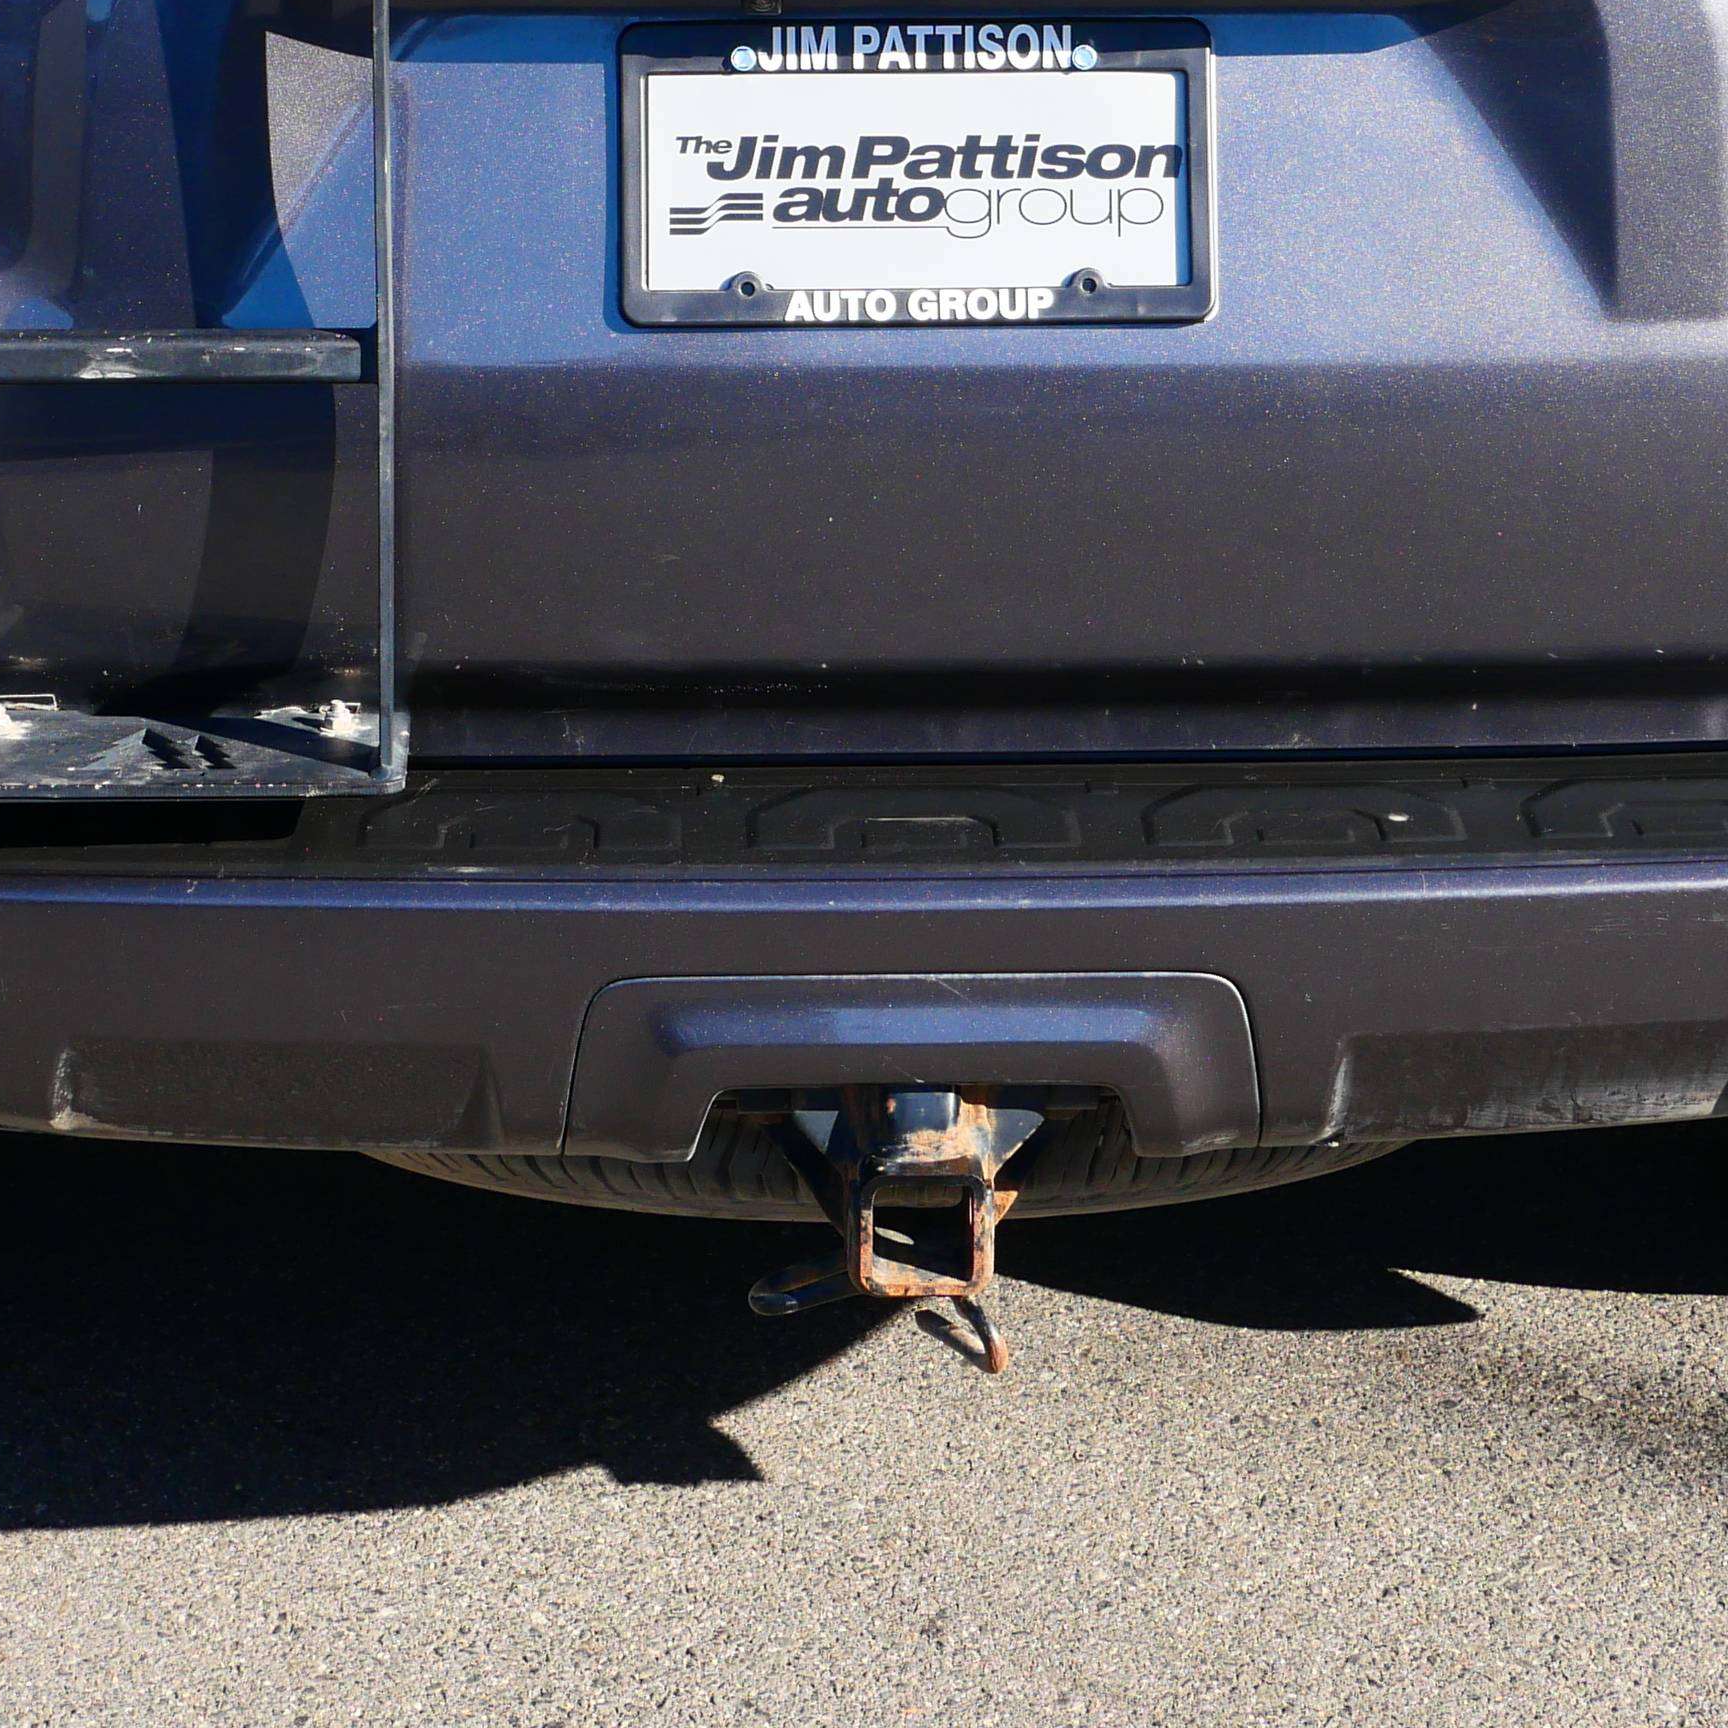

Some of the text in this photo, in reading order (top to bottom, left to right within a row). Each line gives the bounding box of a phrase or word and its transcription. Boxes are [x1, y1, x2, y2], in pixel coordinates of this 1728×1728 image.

[758, 24, 1071, 70] JIM PATTISON
[676, 134, 1184, 180] The Jim Pattison
[784, 288, 1054, 322] AUTO GROUP
